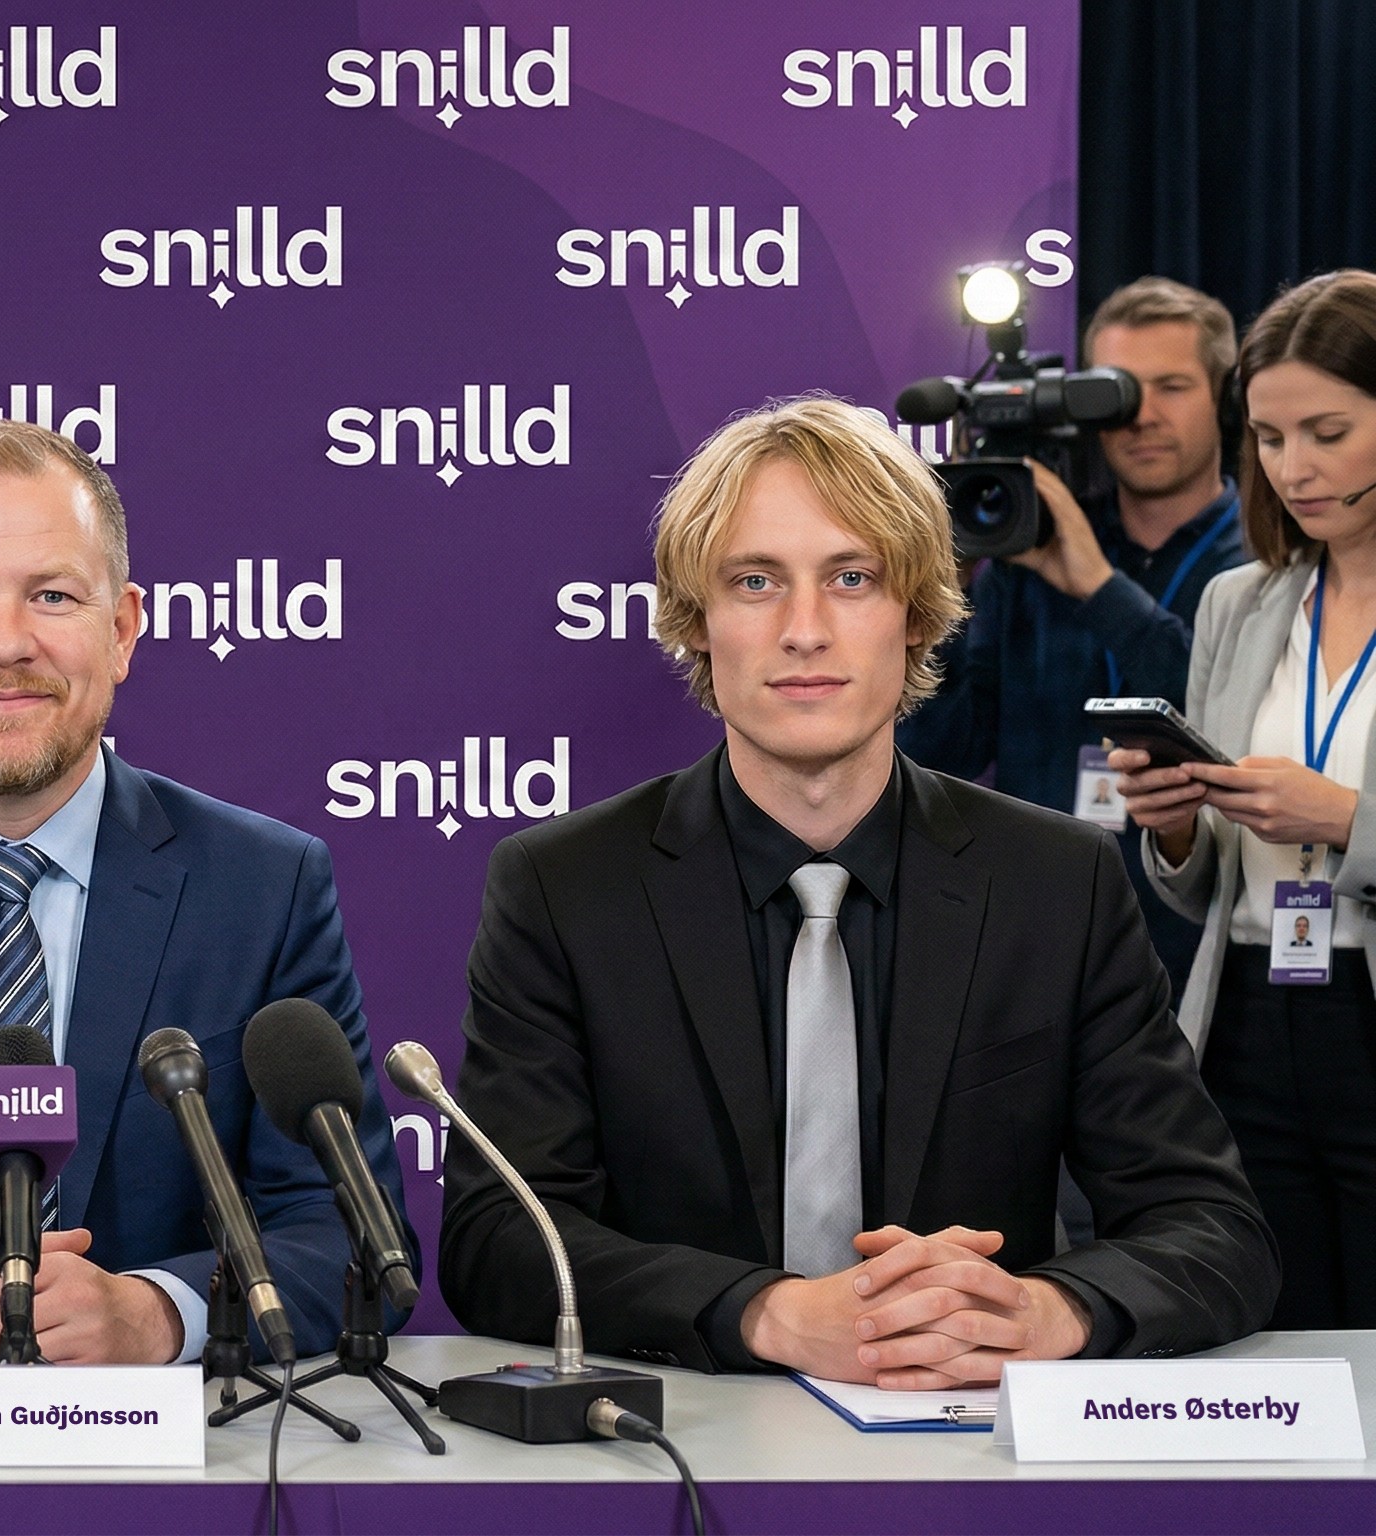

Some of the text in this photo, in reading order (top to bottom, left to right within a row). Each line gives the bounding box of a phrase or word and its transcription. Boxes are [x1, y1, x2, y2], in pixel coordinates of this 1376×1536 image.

[325, 26, 570, 108] snilld
[781, 26, 1026, 108] snilld
[99, 206, 343, 287] snilld
[554, 206, 798, 287] snilld
[325, 384, 570, 466] snilld
[132, 558, 342, 640] nilld
[324, 736, 570, 819] snilld
[10, 1404, 159, 1430] Guðjónsson
[1083, 1395, 1300, 1426] Anders Østerby
